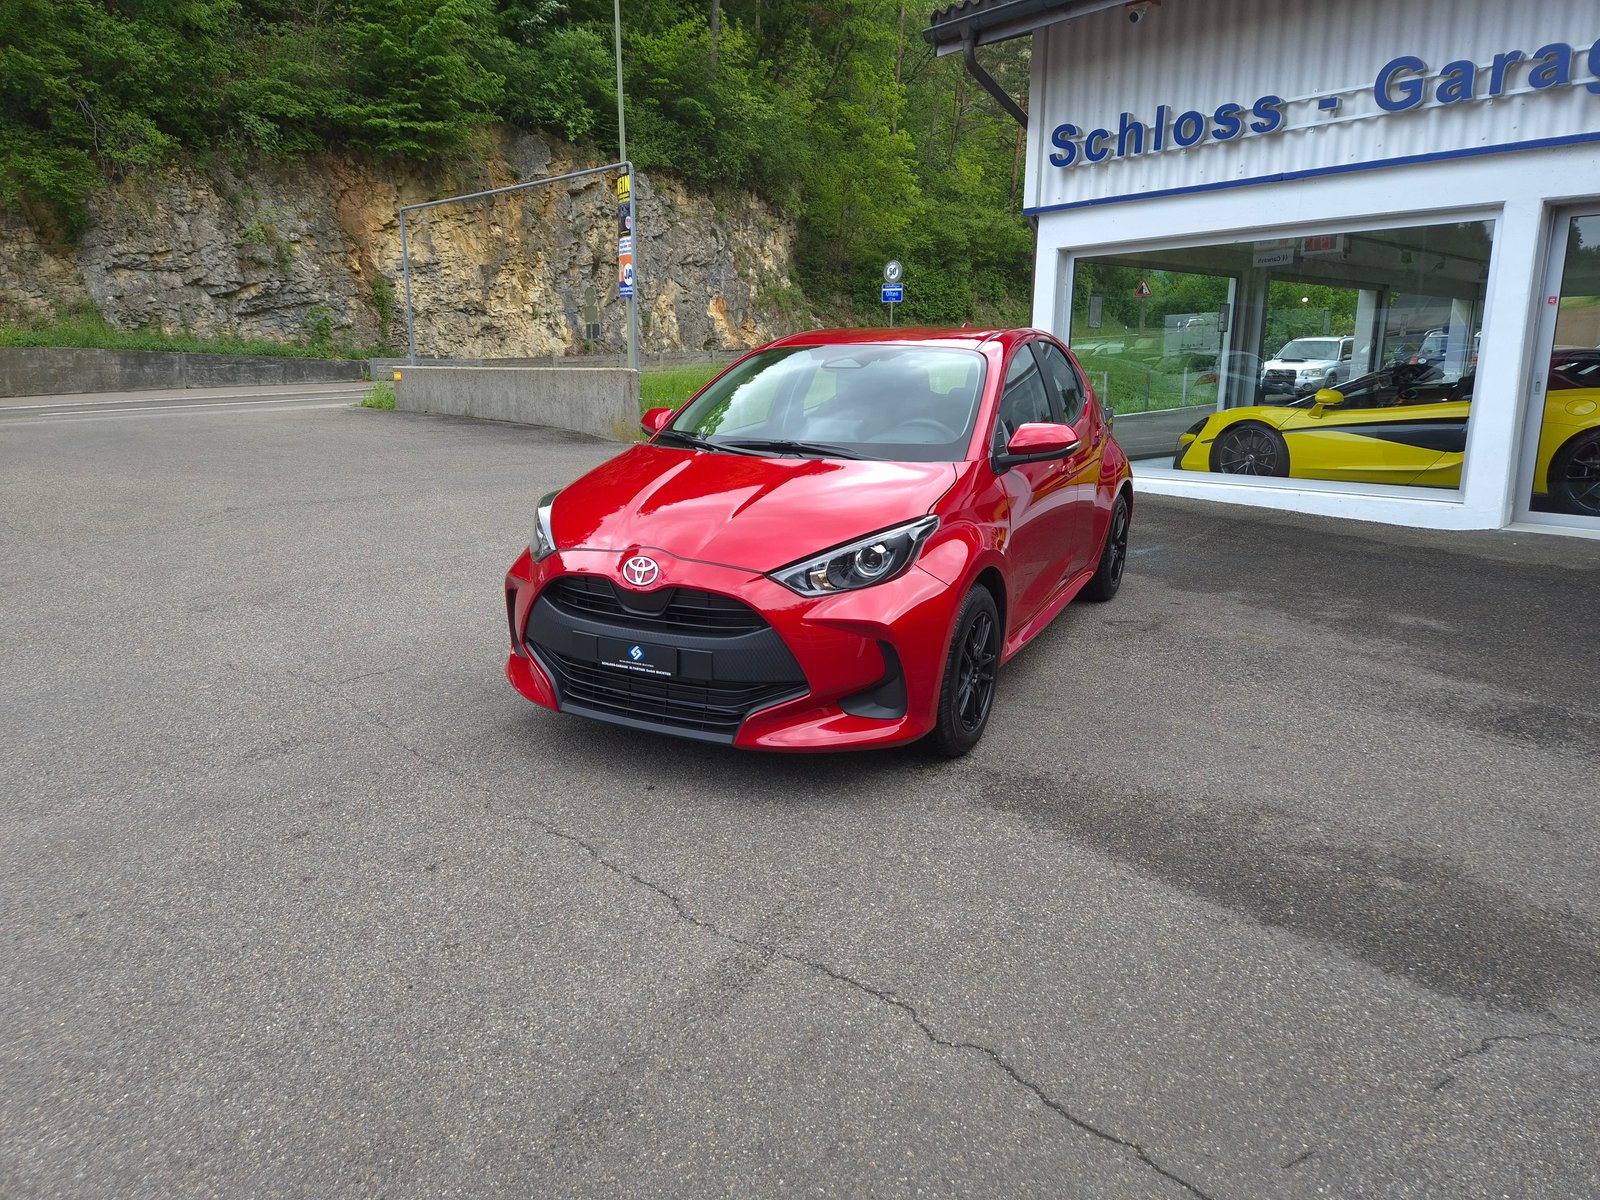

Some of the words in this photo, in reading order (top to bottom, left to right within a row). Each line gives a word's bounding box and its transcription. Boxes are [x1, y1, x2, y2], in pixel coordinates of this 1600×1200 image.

[1049, 95, 1286, 168] Schloss
[1317, 97, 1342, 111] -
[1374, 38, 1600, 112] Gara
[624, 268, 633, 280] JA
[889, 267, 897, 276] 50
